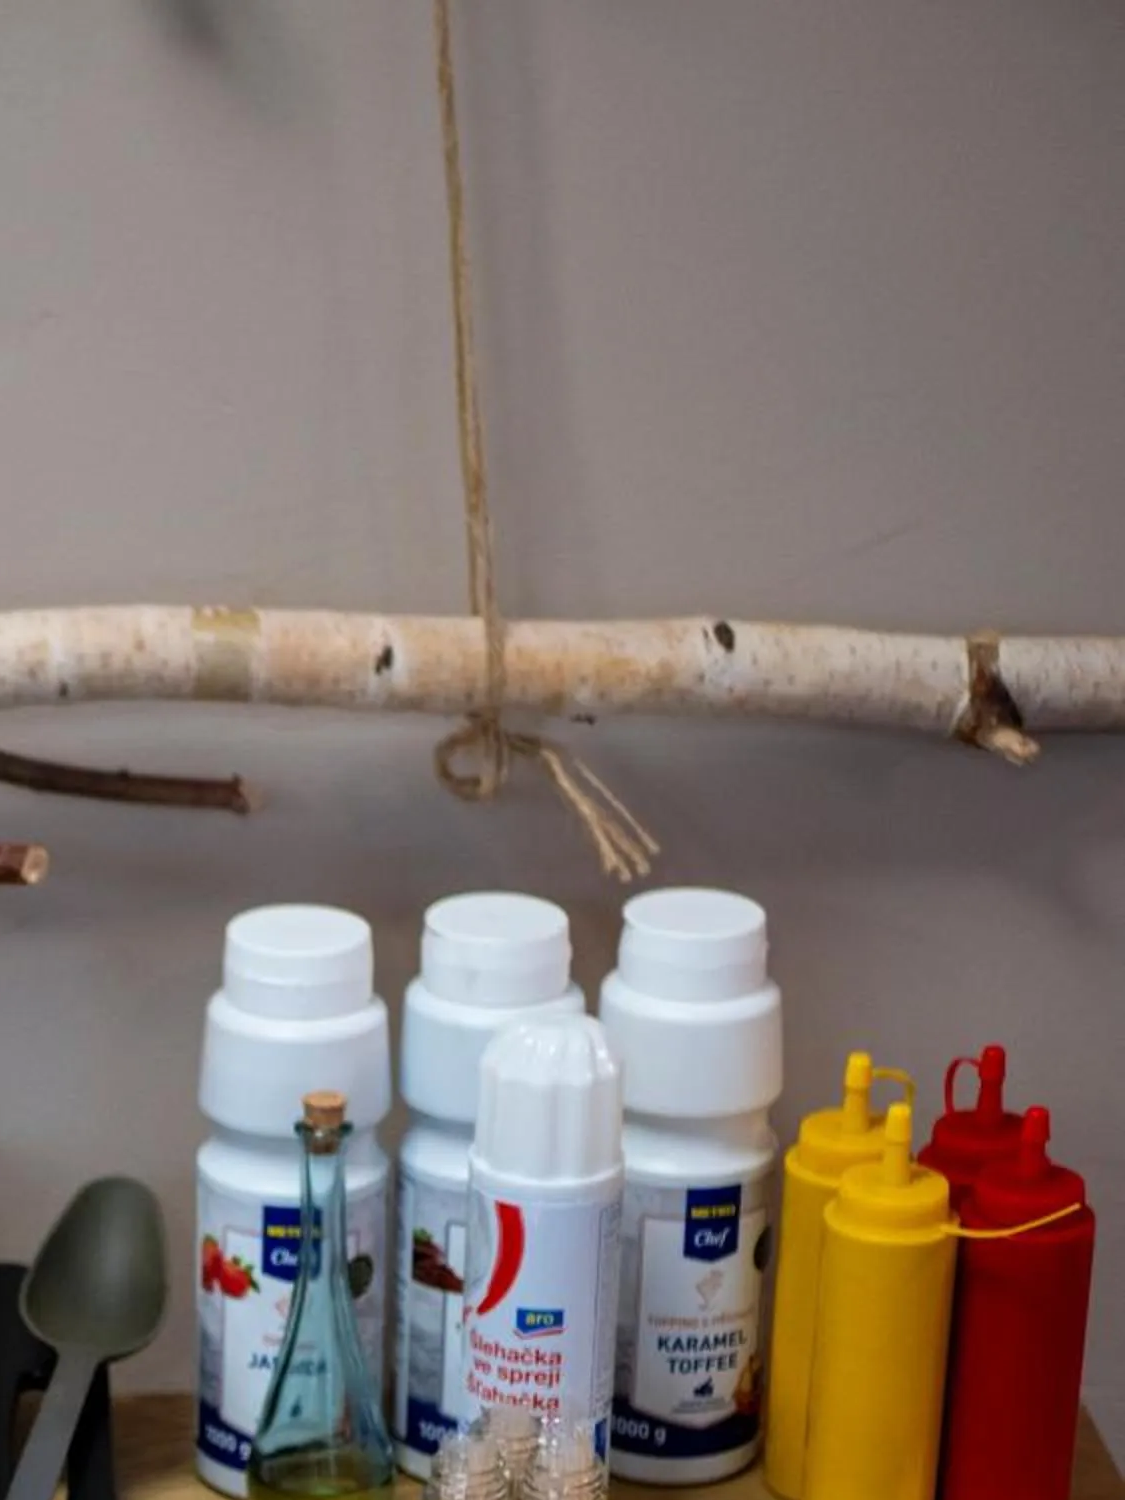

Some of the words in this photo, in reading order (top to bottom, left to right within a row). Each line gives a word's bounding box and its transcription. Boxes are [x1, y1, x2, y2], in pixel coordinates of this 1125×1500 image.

[694, 1226, 731, 1248] Chef
[526, 1313, 555, 1326] aro
[657, 1330, 747, 1352] KARAMEL
[668, 1353, 738, 1375] TOFFEE
[497, 1366, 561, 1389] spreji
[655, 1428, 667, 1446] g
